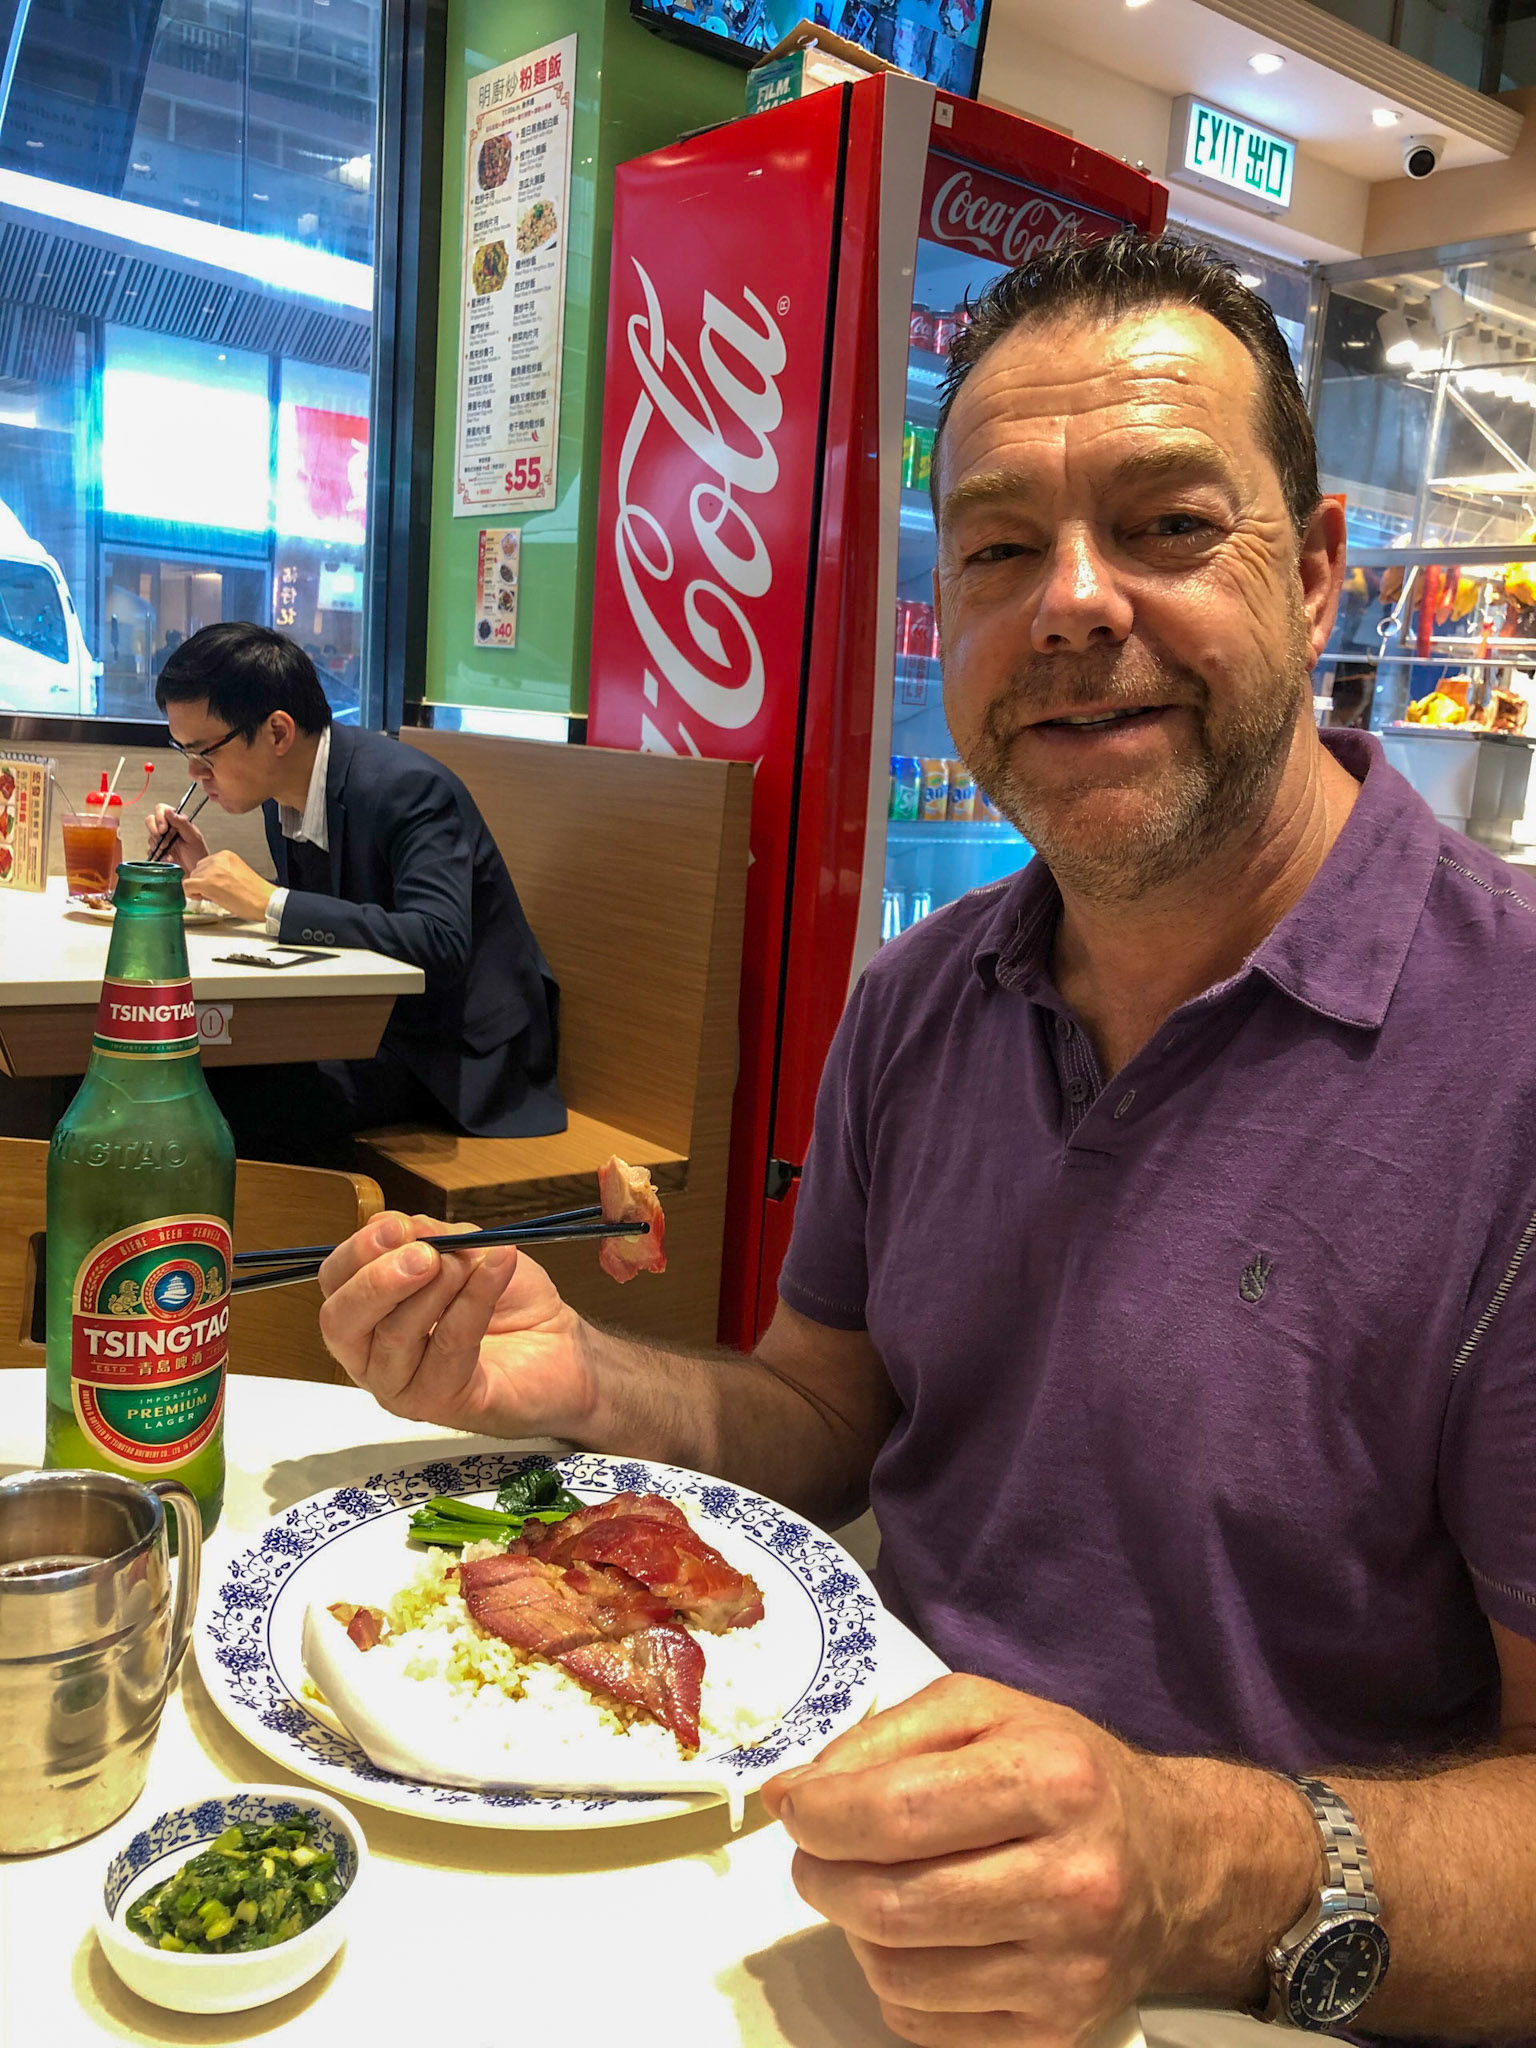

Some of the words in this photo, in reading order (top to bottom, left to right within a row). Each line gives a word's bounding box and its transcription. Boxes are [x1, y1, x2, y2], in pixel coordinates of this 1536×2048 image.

[479, 53, 562, 107] 明廚炒粉麵飯
[1194, 109, 1244, 178] EXIT
[1245, 134, 1288, 198] 出口
[931, 171, 1083, 261] Coca-Col
[504, 456, 541, 494] $55
[614, 256, 787, 757] -Cola
[109, 1001, 195, 1022] TSINGTAO
[159, 1228, 183, 1242] BEER
[83, 1305, 229, 1358] TSINGTAO
[139, 1351, 203, 1376] 青島啤酒
[127, 1393, 208, 1420] PREMIUM
[140, 1387, 199, 1405] IMPORTED
[144, 1412, 195, 1430] LAGER
